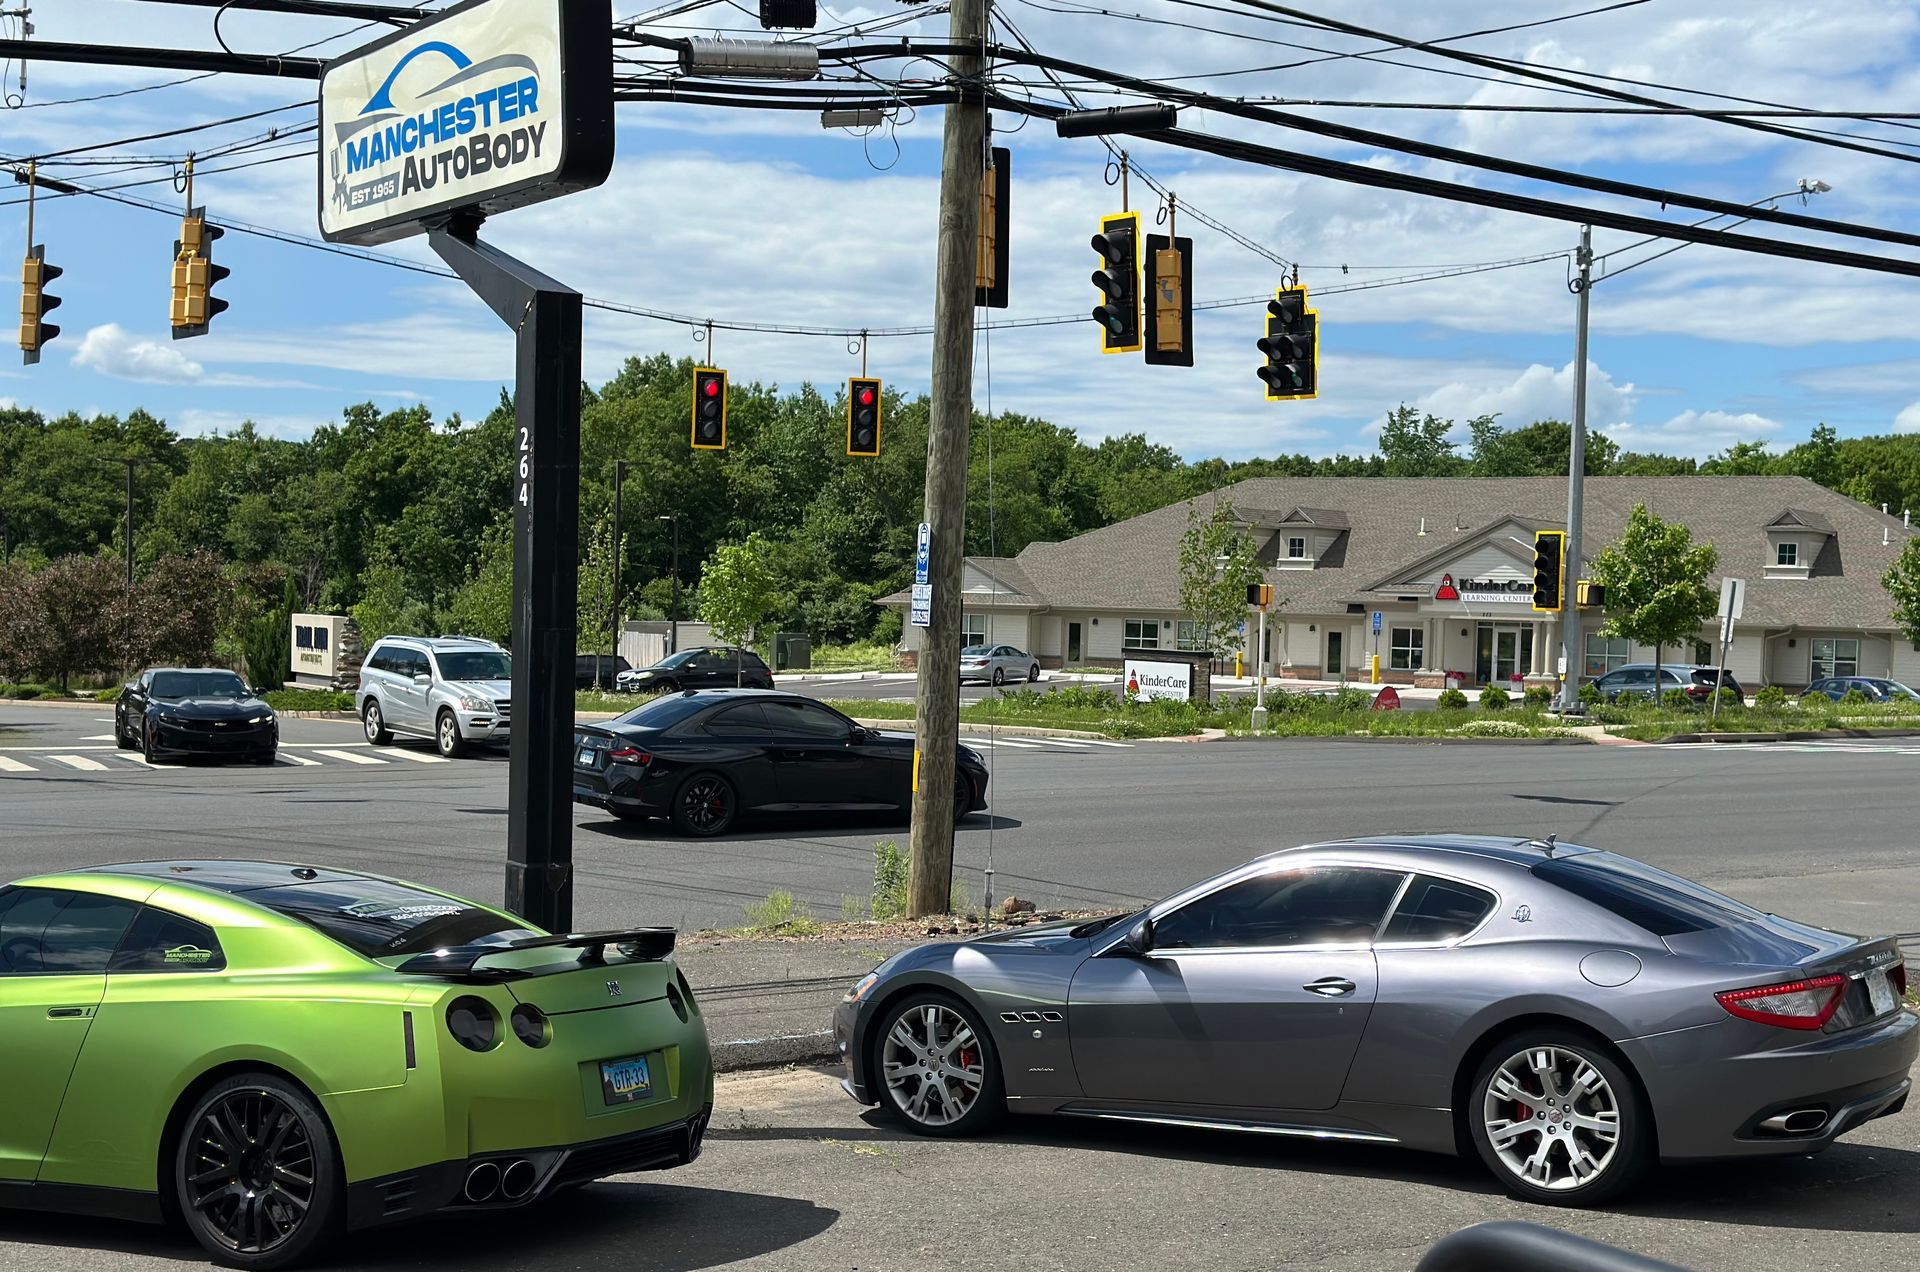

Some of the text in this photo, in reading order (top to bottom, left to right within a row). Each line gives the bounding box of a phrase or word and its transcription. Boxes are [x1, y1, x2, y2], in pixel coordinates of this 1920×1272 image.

[346, 76, 539, 174] MANCHESTER
[351, 180, 395, 205] EST 1965
[519, 426, 529, 507] 264
[1458, 578, 1536, 592] KinderCar
[1140, 674, 1187, 688] KinderCare
